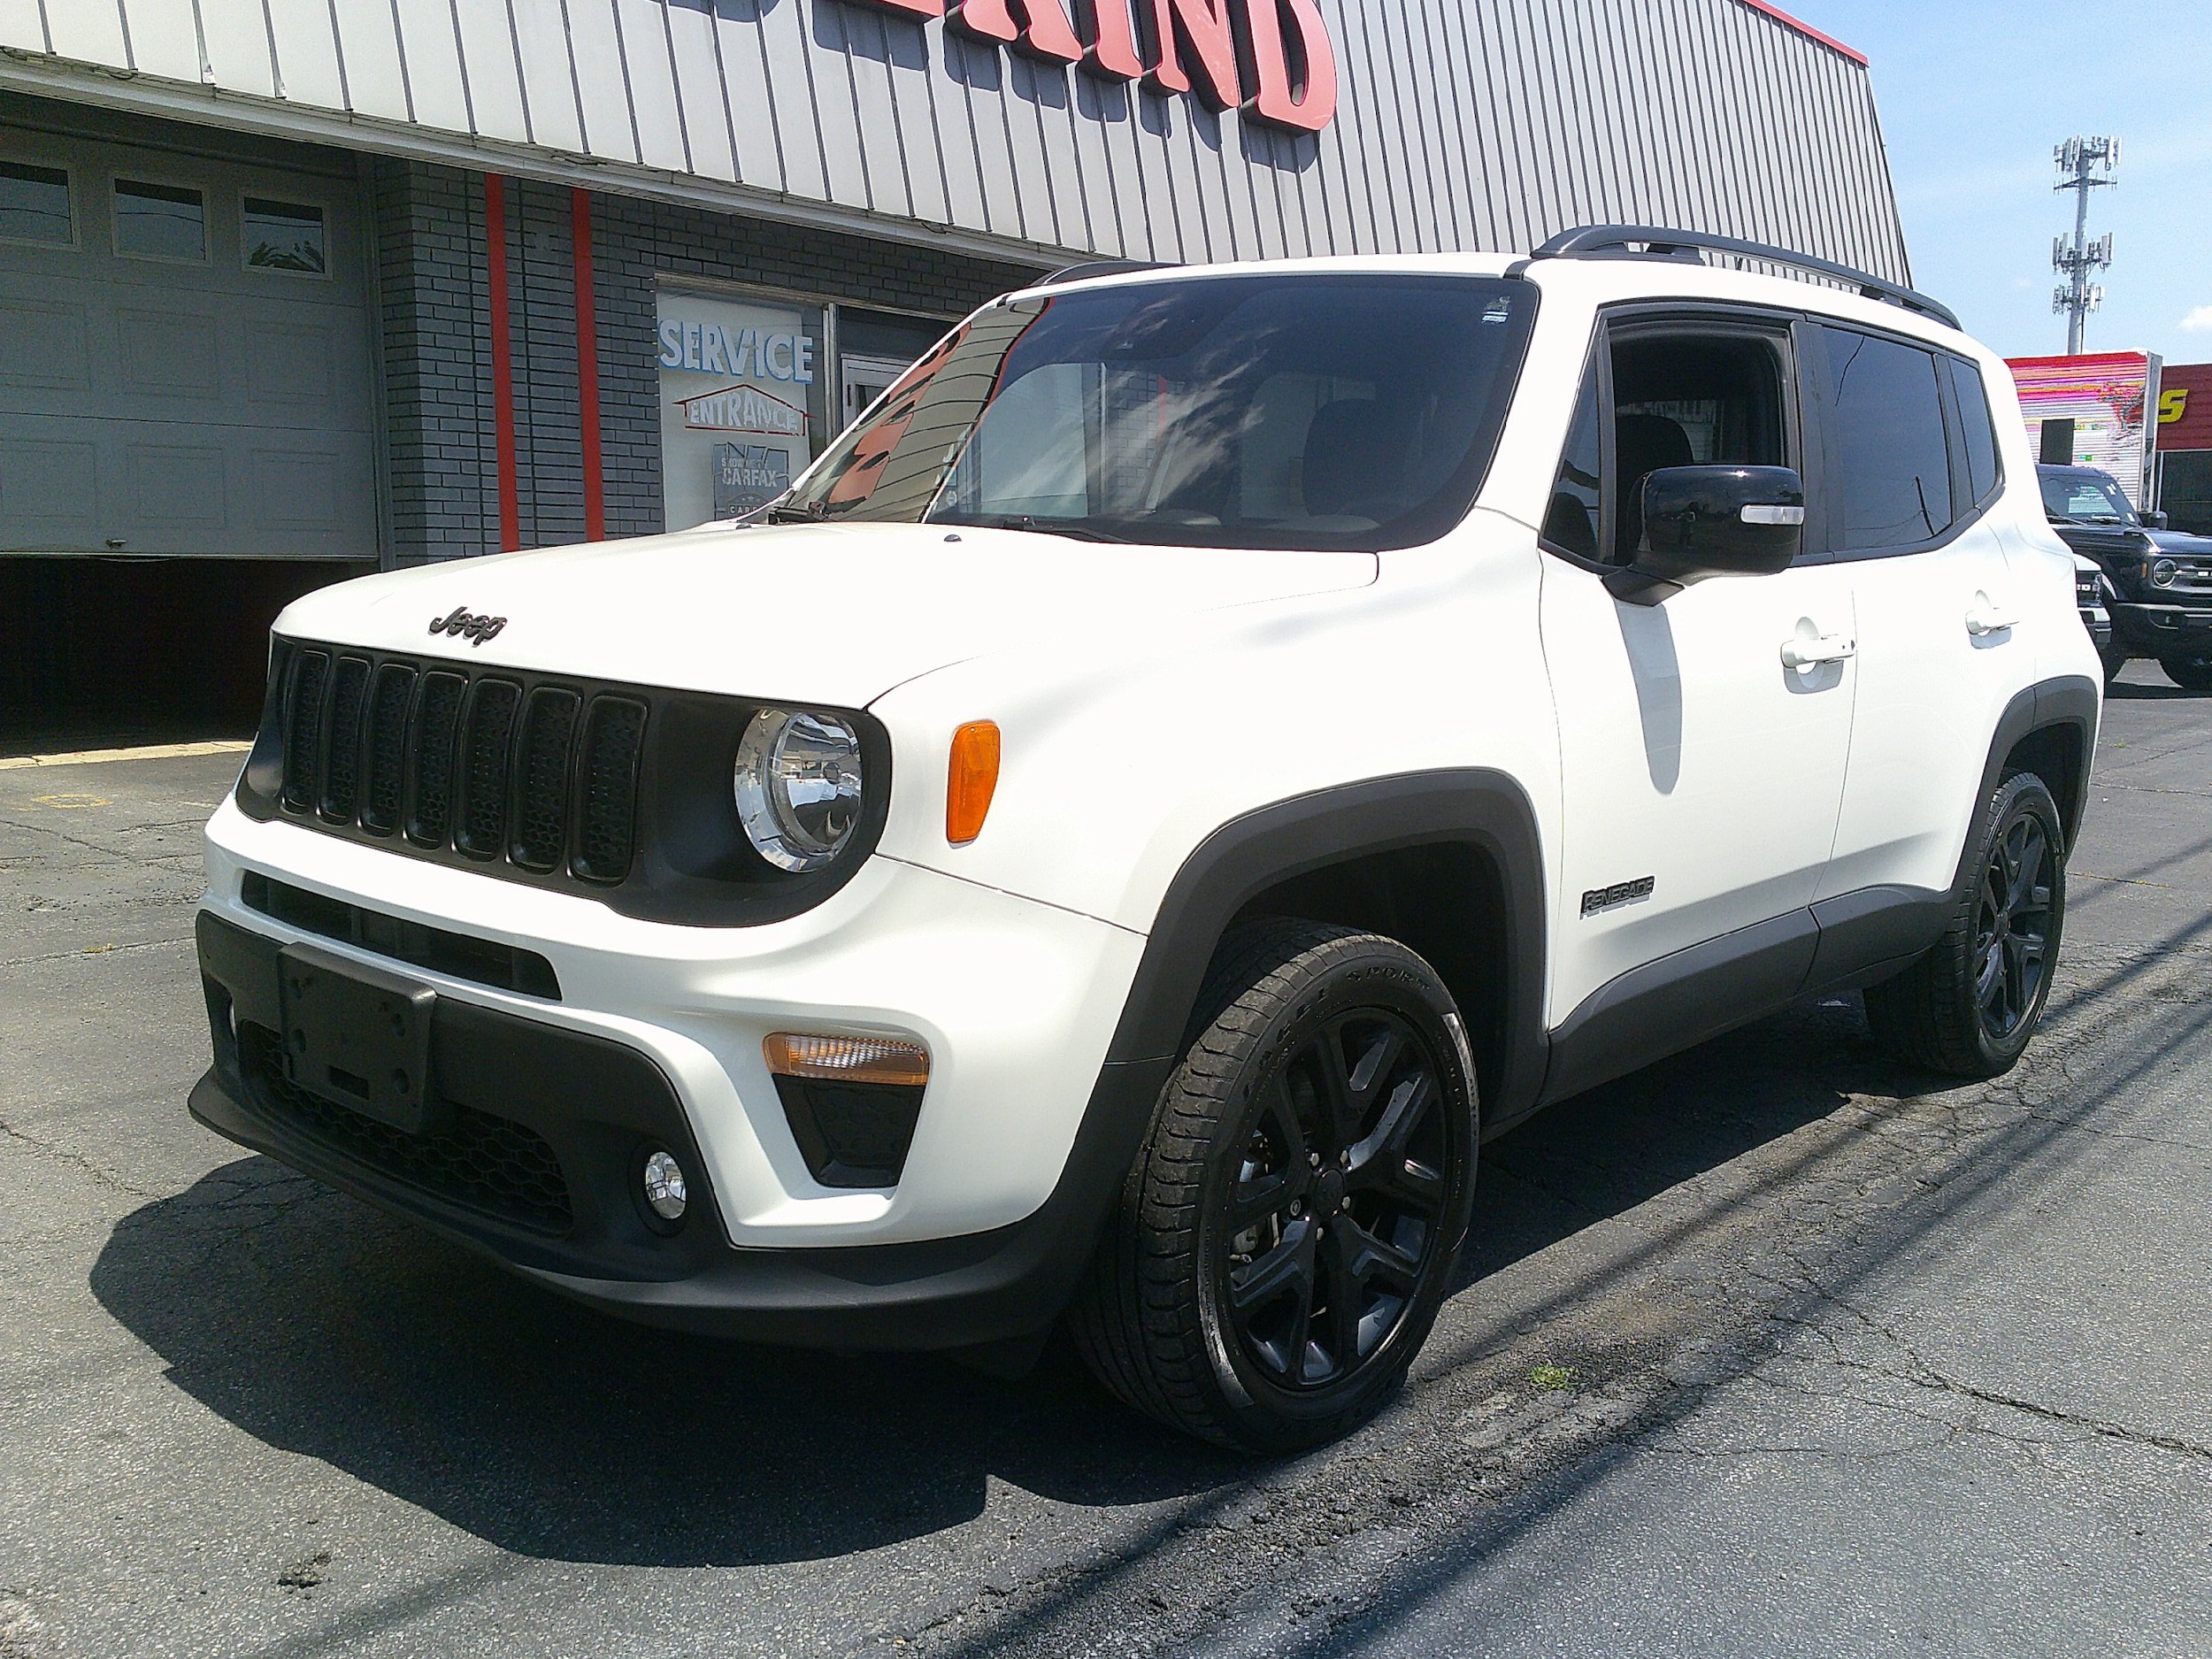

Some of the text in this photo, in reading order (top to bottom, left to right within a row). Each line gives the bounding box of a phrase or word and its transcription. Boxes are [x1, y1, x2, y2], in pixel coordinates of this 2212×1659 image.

[658, 319, 813, 384] SERVICE
[689, 389, 797, 431] ENTRANCE
[722, 467, 777, 488] CARFAX
[429, 606, 508, 647] Jeep
[1580, 876, 1654, 914] RENEGADE
